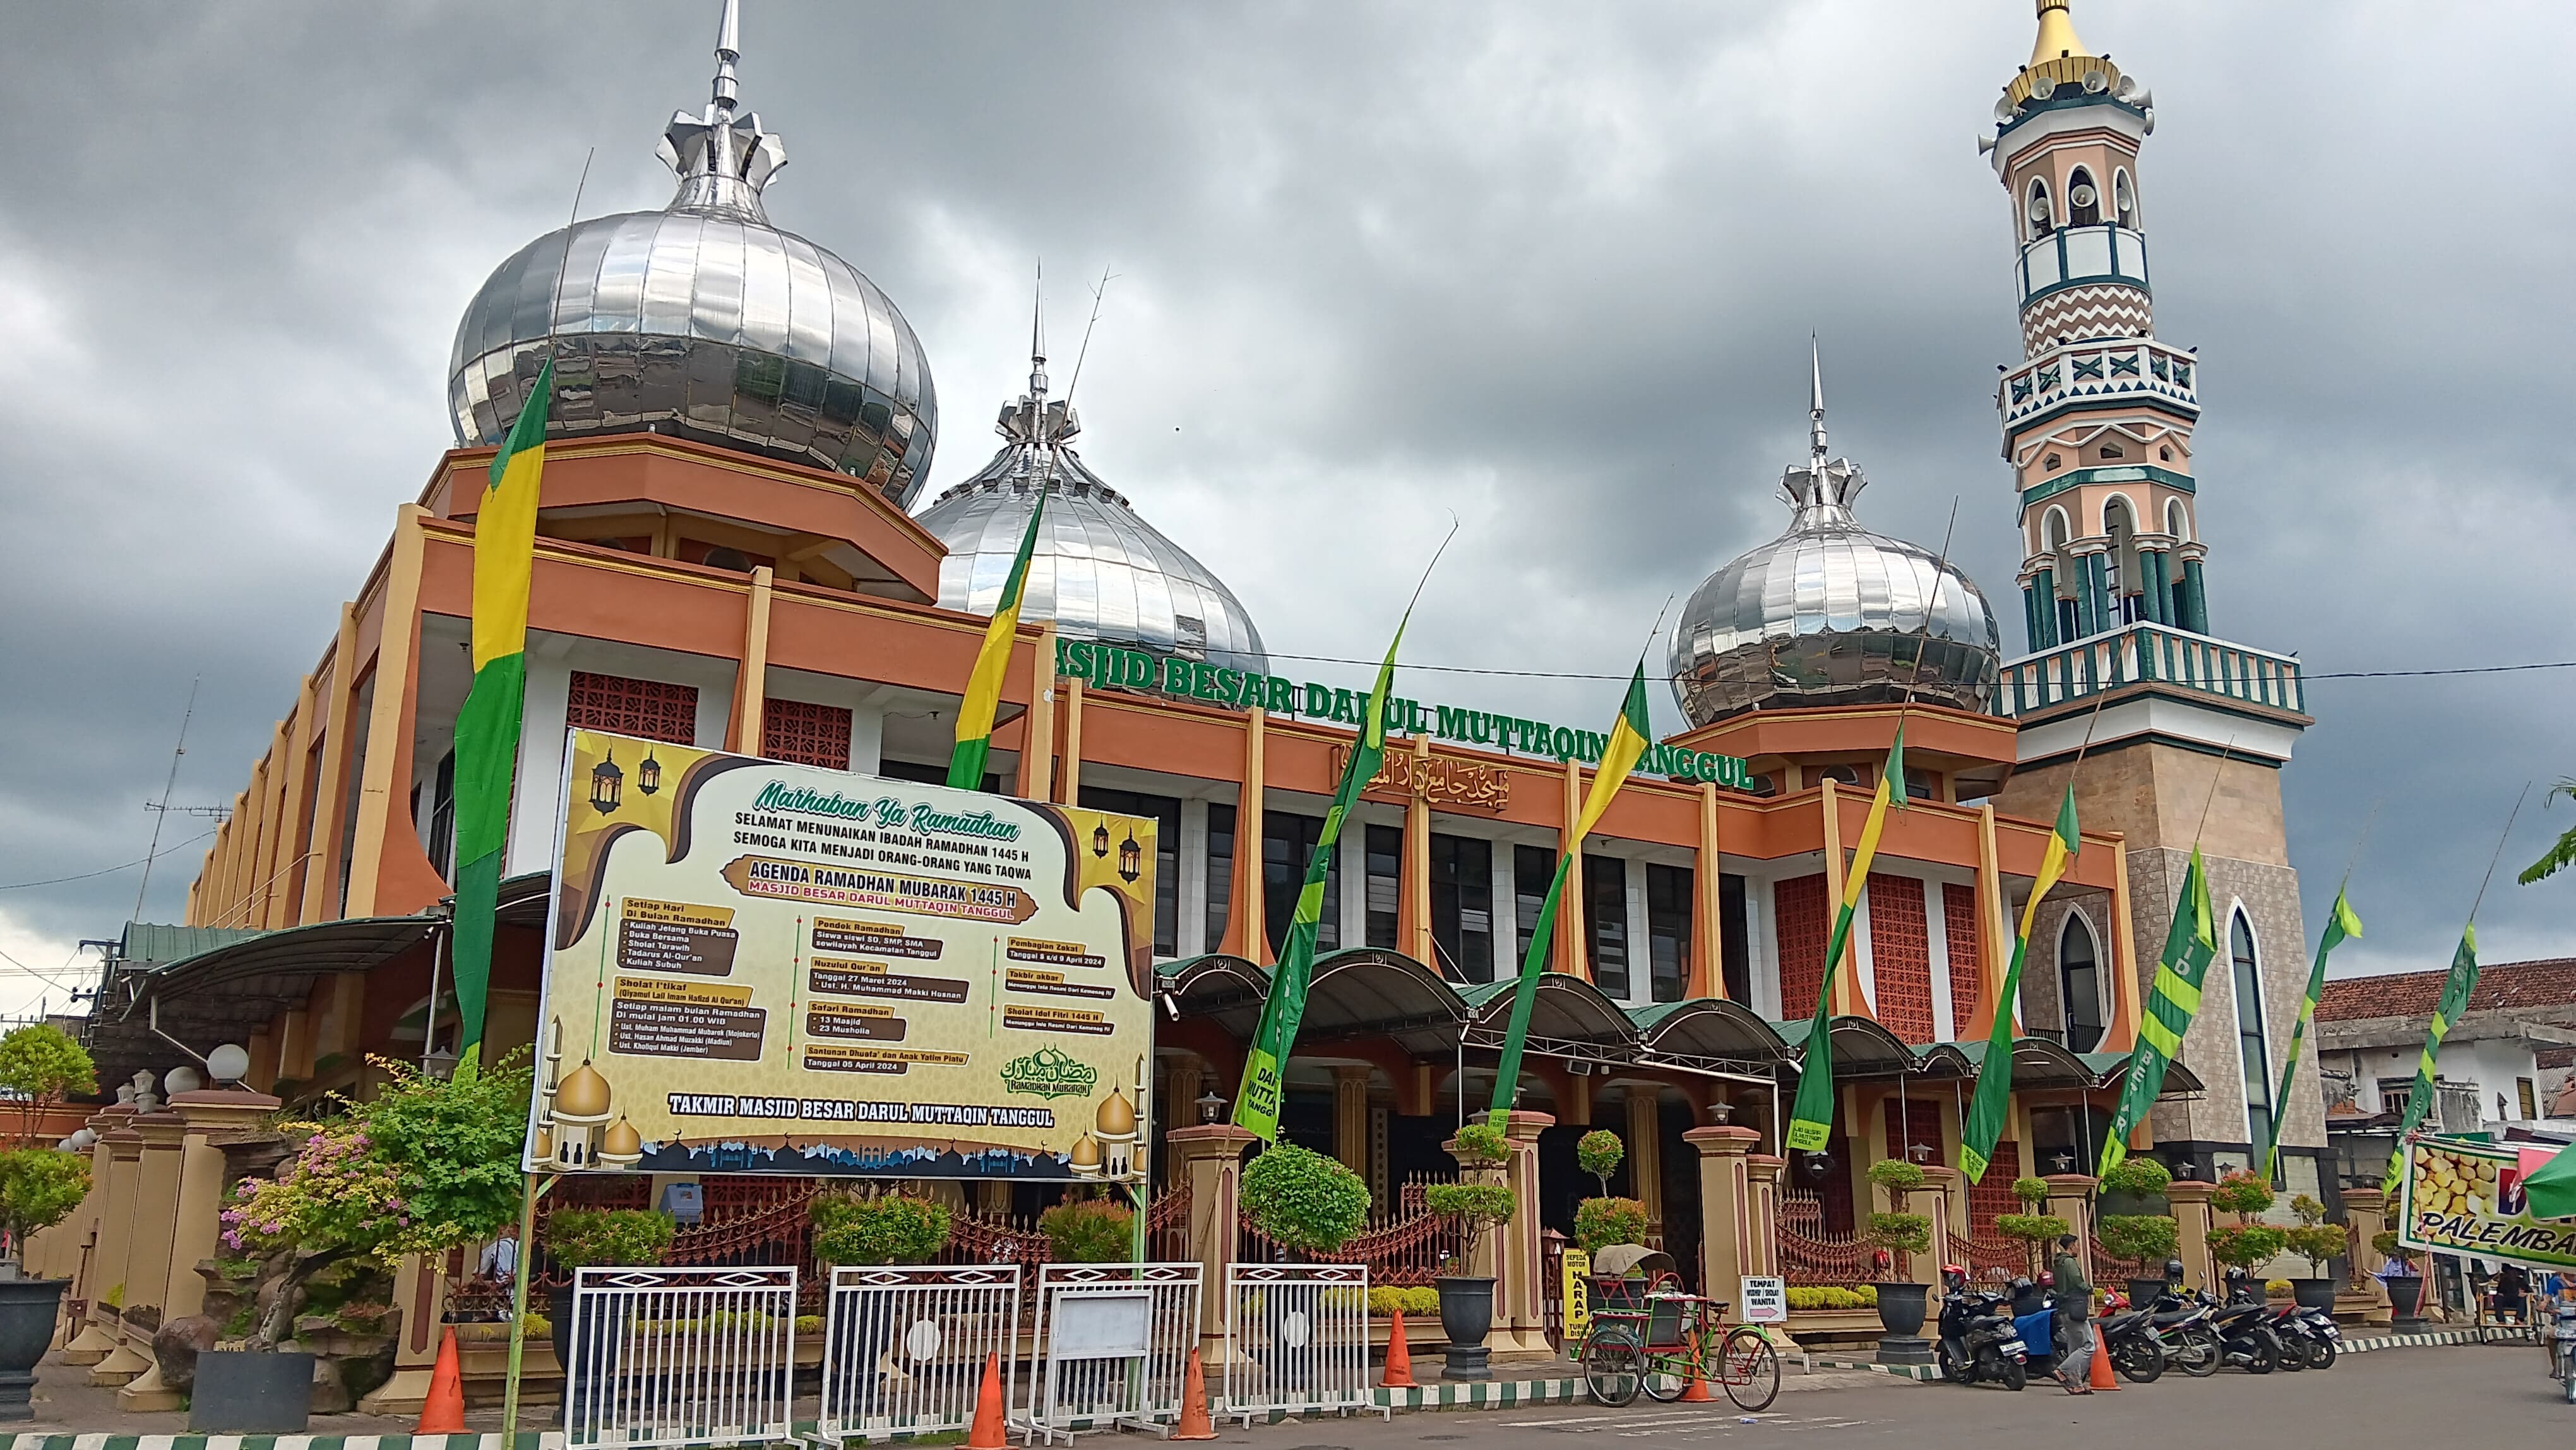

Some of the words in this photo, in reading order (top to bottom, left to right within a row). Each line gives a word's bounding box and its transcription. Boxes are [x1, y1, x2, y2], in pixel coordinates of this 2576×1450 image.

[1162, 657, 1292, 713] BESAR
[1434, 704, 1609, 763] MUTTAQIN
[1634, 743, 1754, 790] ANGGUL
[753, 781, 870, 820] Marhaban
[874, 797, 908, 827] Ya
[910, 803, 1020, 841] Ramadhan
[736, 812, 792, 830] SELAMAT
[797, 821, 875, 842] MENUNAIKAN
[880, 832, 922, 848] IBADAH
[926, 839, 987, 856] RAMADHAN
[992, 848, 1018, 861] 1445
[1022, 851, 1029, 862] H
[734, 831, 786, 849] SEMOGA
[790, 839, 816, 853] KITA
[821, 842, 874, 860] MENJADI
[878, 850, 960, 871] ORANG-ORANG
[963, 861, 991, 875] YANG
[995, 865, 1031, 880] TAQWA
[749, 861, 809, 883] AGENDA
[814, 869, 894, 892] RAMADHAN
[900, 879, 966, 901] MUBARAK
[971, 888, 1002, 905] 1445
[1007, 892, 1016, 906] H
[628, 900, 659, 912] Setiap
[664, 904, 684, 912] Hari
[749, 881, 799, 895] MASJID
[803, 888, 845, 901] BESAR
[849, 892, 890, 905] DARUL
[895, 897, 957, 913] MUTTAQIN
[961, 905, 1014, 919] TANGGUL
[641, 911, 669, 920] Bulan
[673, 915, 725, 926] Ramadhan
[630, 922, 656, 930] Kuliah
[659, 925, 686, 934] Jelang
[689, 927, 708, 935] Buka
[711, 930, 736, 938] Puasa
[818, 921, 851, 930] Pondok
[854, 925, 900, 935] Ramadhan
[653, 933, 689, 942] Bersama
[817, 932, 842, 940] Siswa
[844, 933, 864, 942] siswi
[905, 939, 923, 947] SMA
[628, 940, 655, 949] Sholat
[657, 942, 689, 951] Tarawih
[859, 944, 904, 954] Kecamatan
[907, 946, 937, 957] Tanggul
[1011, 940, 1054, 950] Pembagian
[628, 949, 660, 958] Tadarus
[1010, 950, 1038, 959] Tanggal
[627, 958, 653, 966] Kuliah
[655, 960, 681, 969] Subuh
[814, 960, 847, 969] Nuzulul
[814, 973, 845, 982] Tanggal
[861, 976, 885, 985] Maret
[1036, 973, 1059, 981] akbar
[620, 980, 652, 988] Sholat
[852, 984, 902, 994] Muhammad
[904, 988, 928, 996] Makki
[667, 992, 686, 1001] Imam
[617, 1002, 647, 1011] Setiap
[650, 1004, 681, 1014] malam
[684, 1007, 710, 1015] bulan
[712, 1009, 760, 1019] Ramadhan
[811, 1004, 838, 1012] Safari
[842, 1006, 888, 1016] Ramadhan
[629, 1012, 655, 1020] mulai
[678, 1015, 705, 1024] 01.00
[707, 1017, 725, 1025] WIB
[833, 1017, 861, 1026] Masjid
[634, 1033, 653, 1041] Hasan
[655, 1034, 677, 1043] Ahmad
[660, 1026, 696, 1034] Muhammad
[725, 1029, 760, 1040] (Mojokerto)
[681, 1045, 708, 1055] (Jember)
[809, 1048, 846, 1056] Santunan
[808, 1059, 840, 1069] Tanggal
[856, 1062, 874, 1070] April
[669, 1095, 735, 1115] TAKMIR
[739, 1098, 798, 1117] MASJID
[801, 1100, 854, 1119] BESAR
[857, 1103, 909, 1121] DARUL
[911, 1105, 987, 1124] MUTTAQIN
[990, 1109, 1053, 1127] TANGGUL
[2417, 1212, 2576, 1255] PALEMBA
[1573, 1271, 1583, 1319] HARAP
